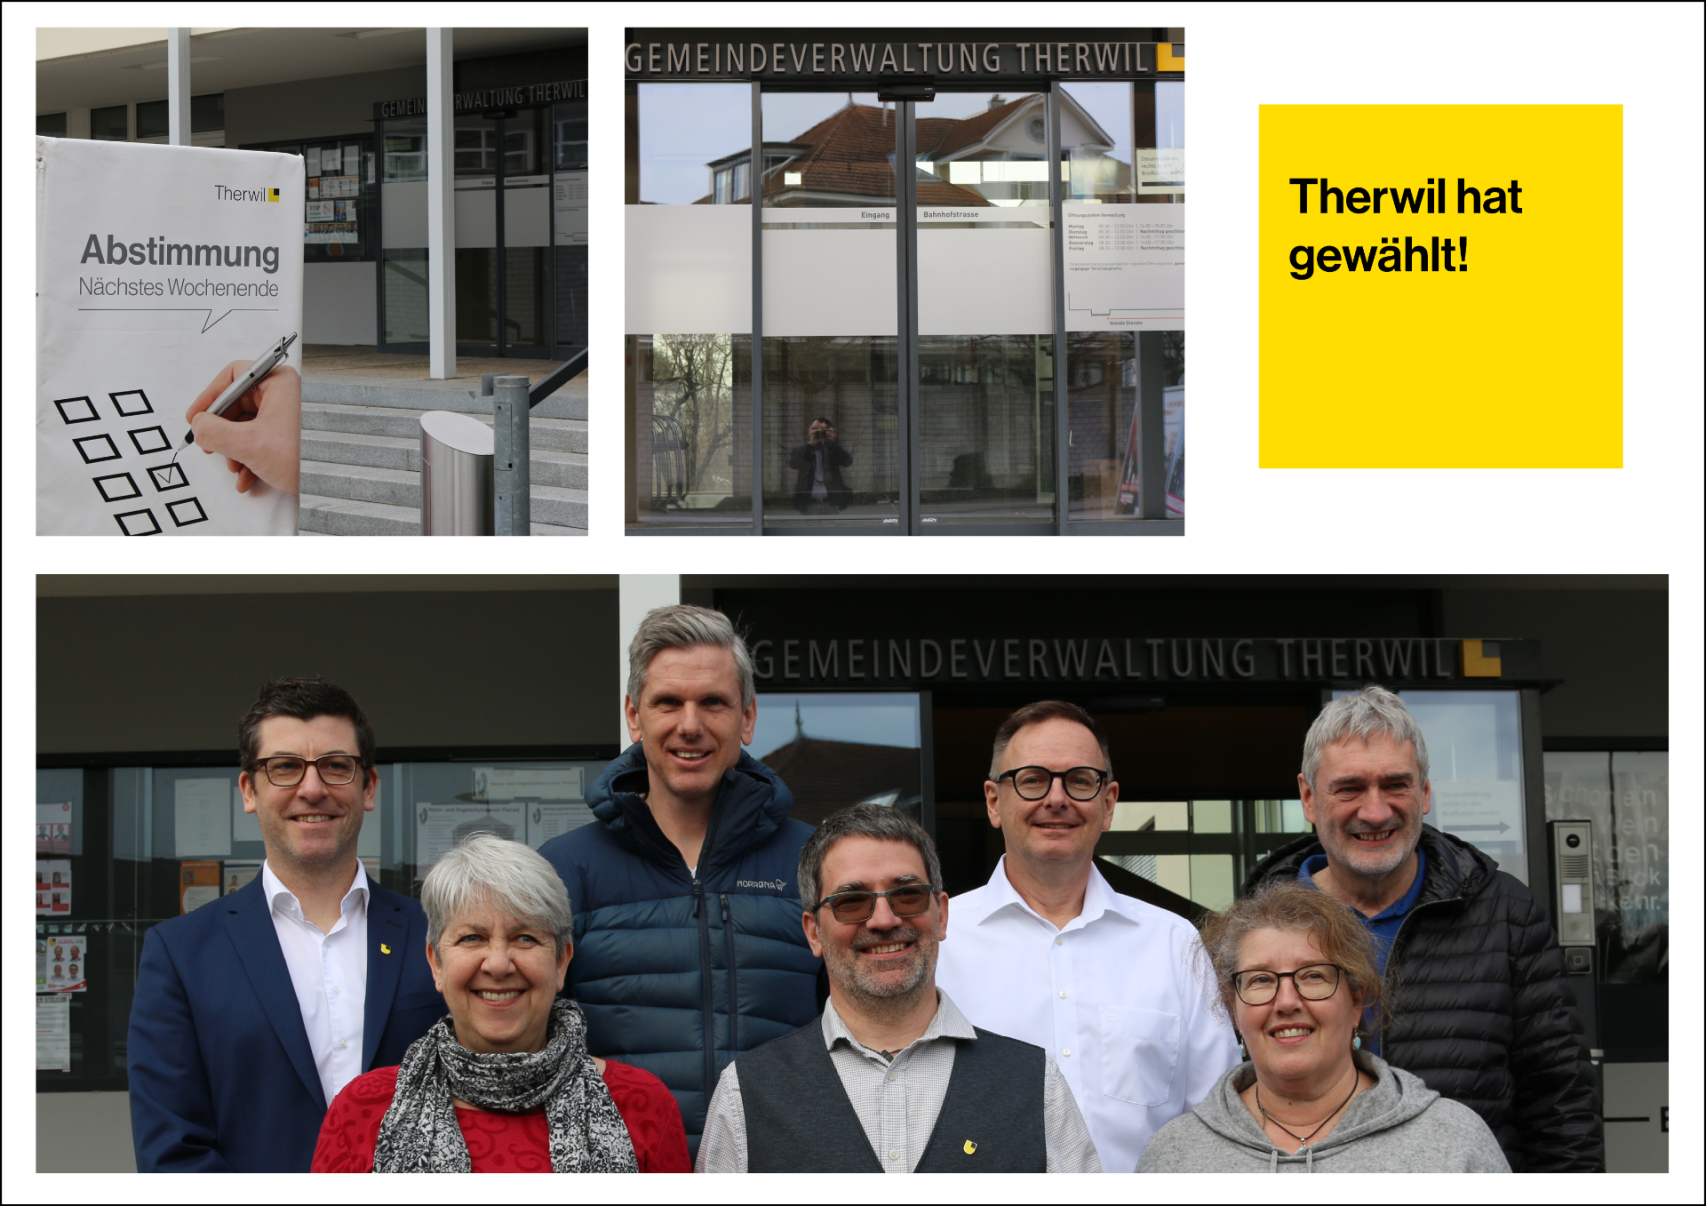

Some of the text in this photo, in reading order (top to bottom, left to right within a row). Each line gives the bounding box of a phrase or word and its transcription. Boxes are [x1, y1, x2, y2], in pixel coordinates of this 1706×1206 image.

[625, 43, 1149, 73] GEMEINDEVERWALTUNG THERWIL
[382, 80, 585, 117] GEMEINRWALTUNG THERWIL
[214, 184, 266, 202] Therwil
[861, 211, 890, 220] Eingang
[80, 234, 280, 274] Abstimmung
[79, 277, 278, 297] Nächstes Wochenende
[754, 639, 1452, 679] GEMEINDEVERWALTUNG THERWIL
